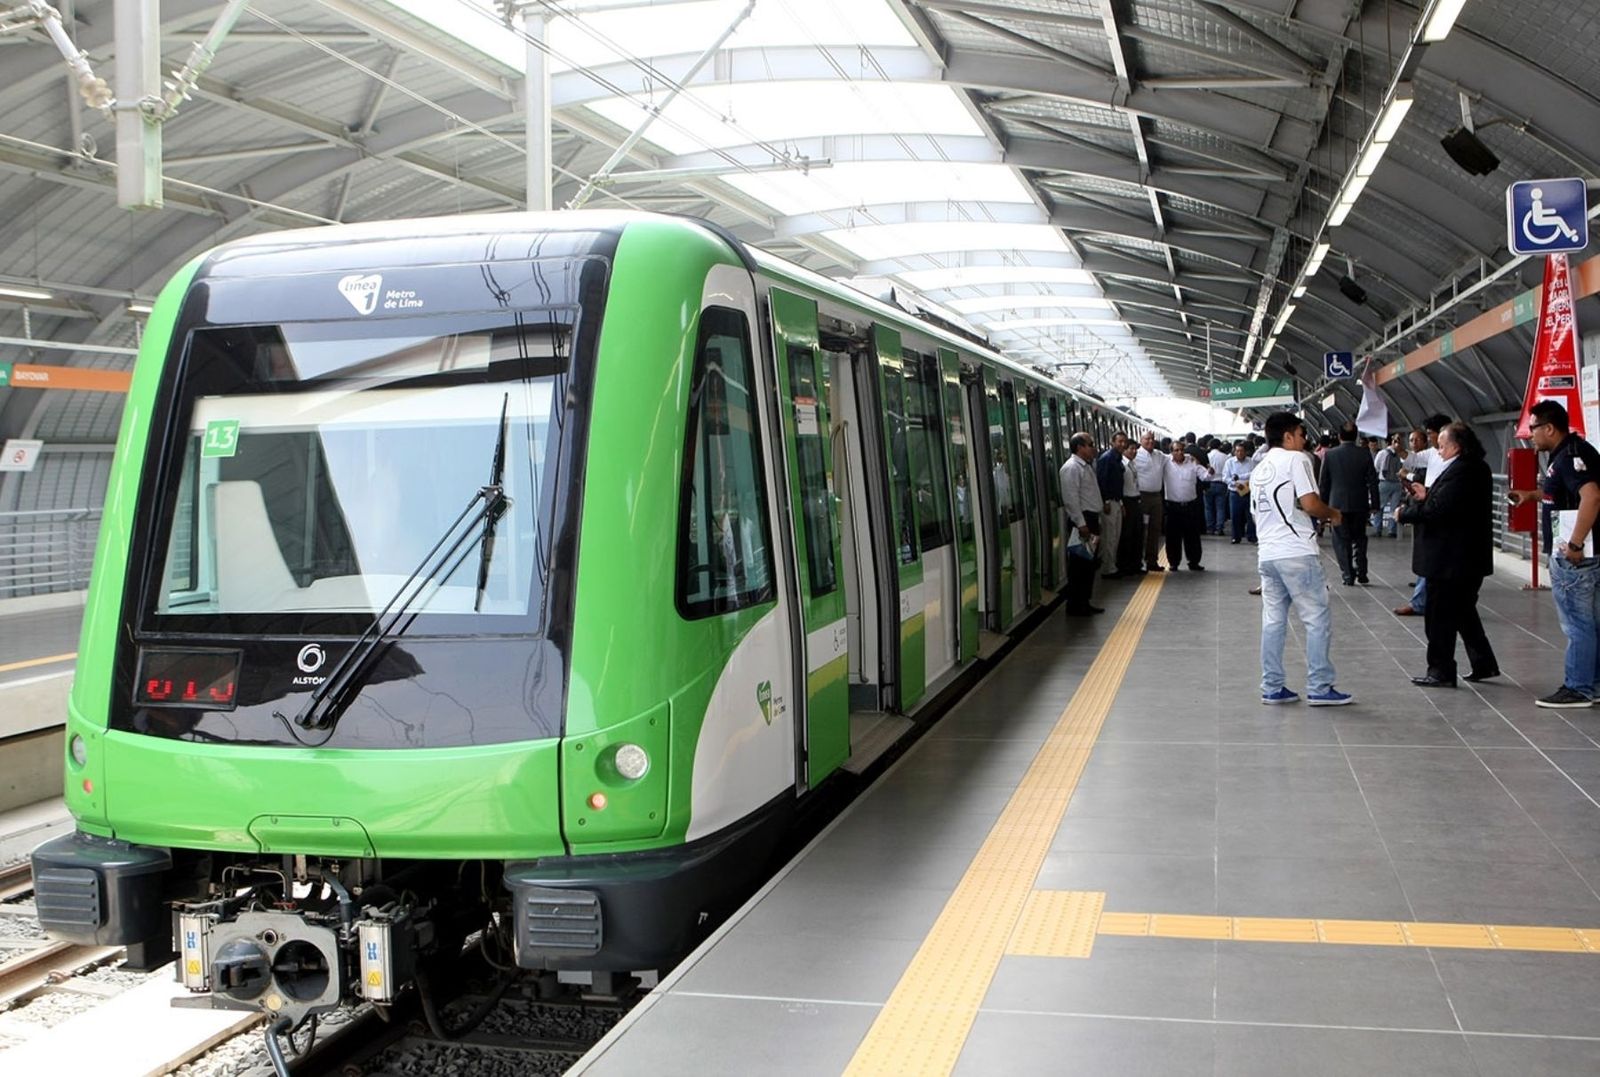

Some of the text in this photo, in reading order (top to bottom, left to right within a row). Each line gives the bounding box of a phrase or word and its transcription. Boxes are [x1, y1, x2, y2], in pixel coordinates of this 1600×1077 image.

[386, 290, 415, 298] Metro
[384, 299, 423, 309] de Lima
[1214, 387, 1242, 395] SALIDA
[206, 426, 236, 449] 13
